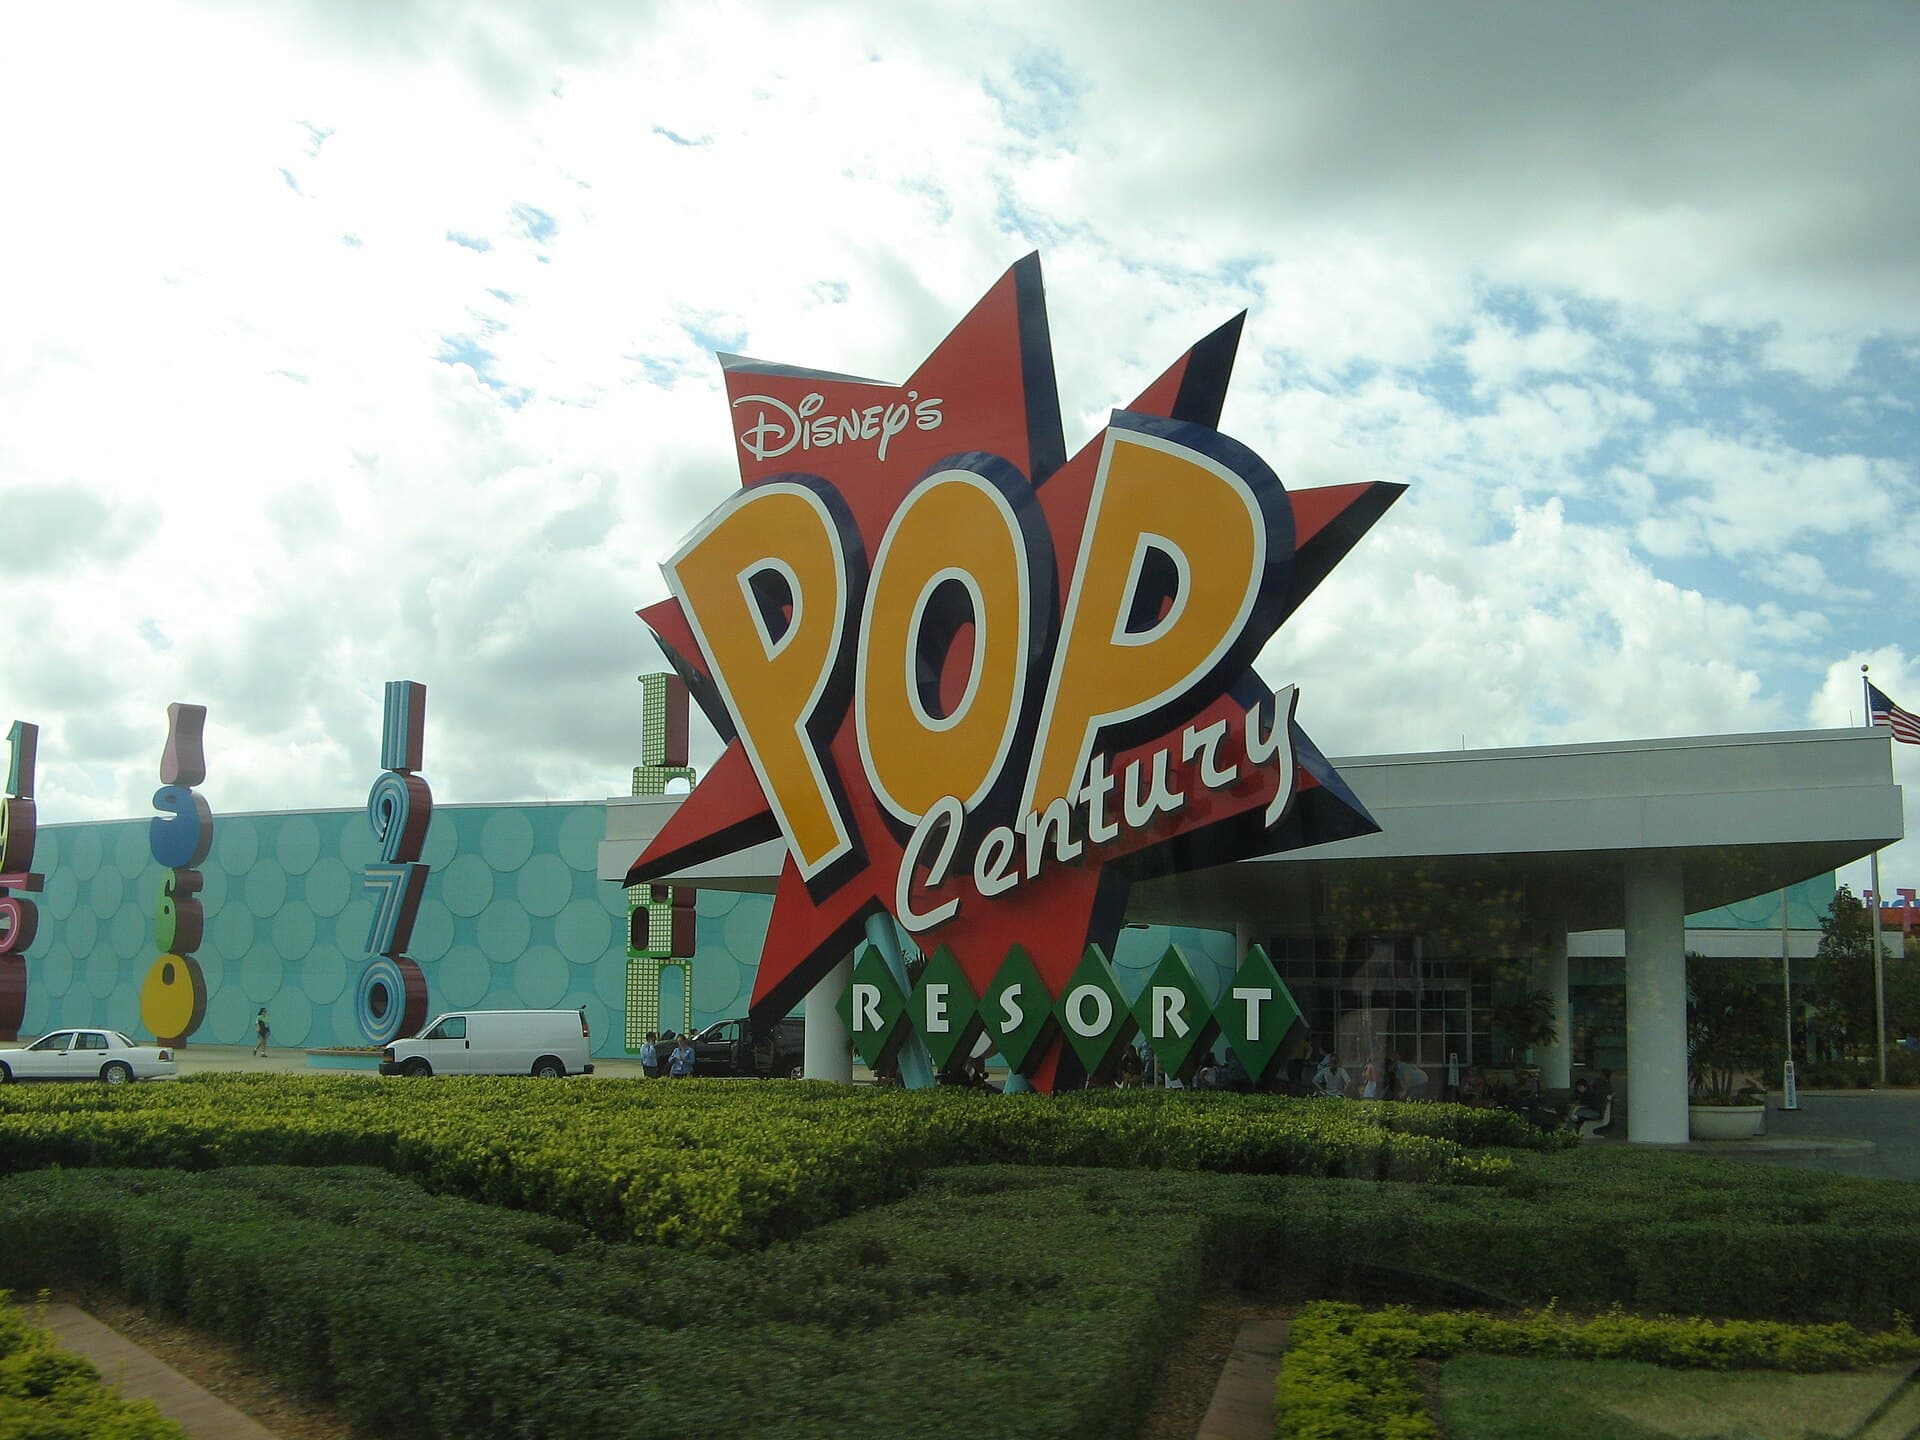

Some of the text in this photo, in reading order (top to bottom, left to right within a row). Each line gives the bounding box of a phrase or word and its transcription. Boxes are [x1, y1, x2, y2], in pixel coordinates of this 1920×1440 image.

[658, 426, 1268, 883] POP
[895, 683, 1296, 932] Century
[852, 983, 1272, 1041] RESORT
